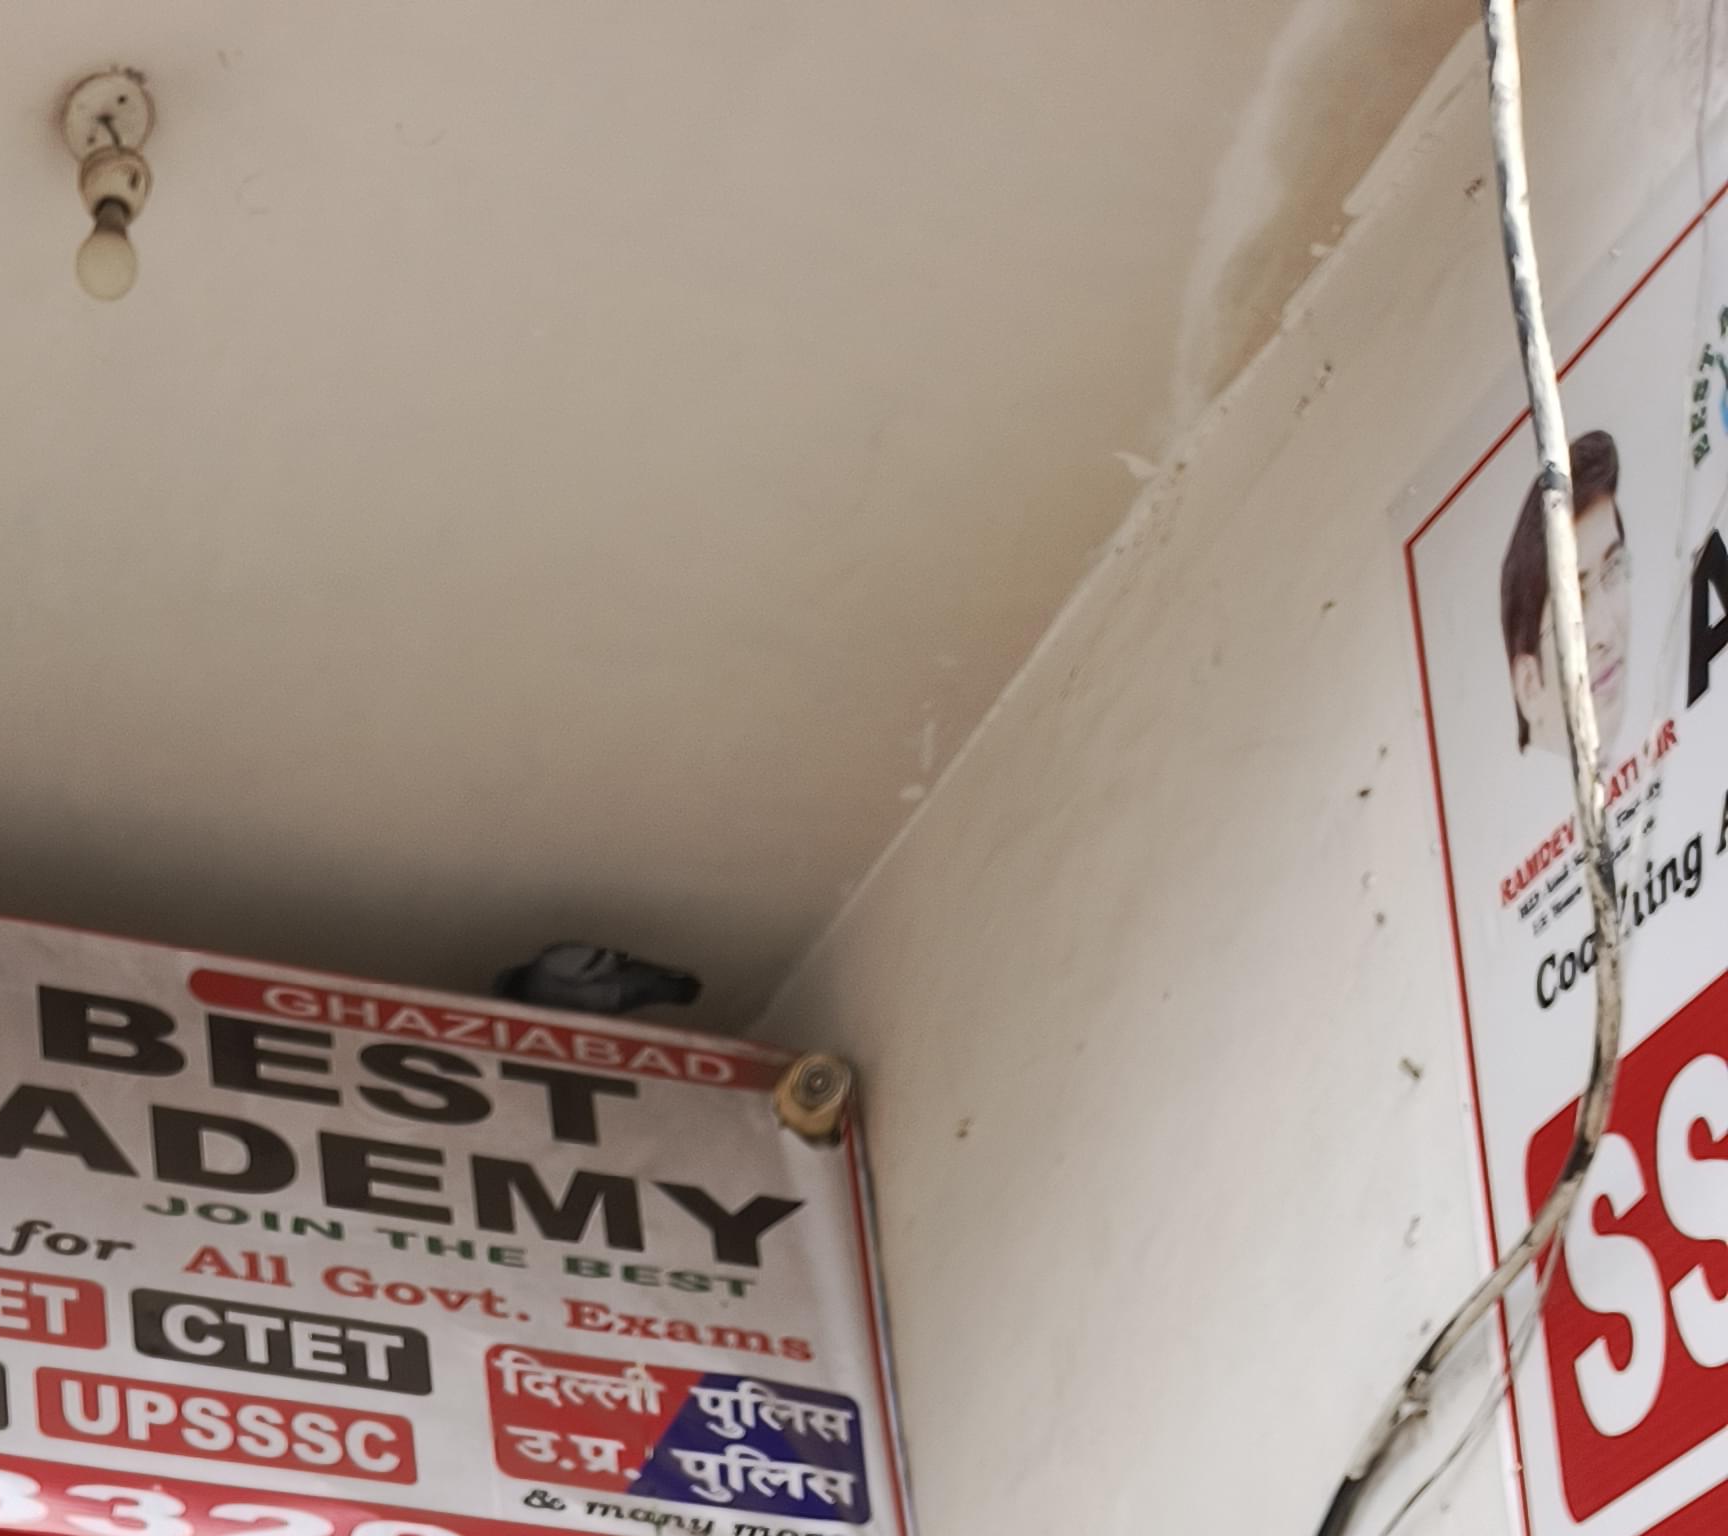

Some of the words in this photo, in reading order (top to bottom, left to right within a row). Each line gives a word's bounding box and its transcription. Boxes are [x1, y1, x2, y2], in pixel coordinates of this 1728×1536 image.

[36, 983, 639, 1145] BEST
[262, 984, 736, 1087] GHAZIABAD
[144, 1197, 347, 1242] JOIN
[377, 1228, 528, 1270] THE
[562, 1255, 758, 1300] BEST
[159, 1303, 405, 1382] CTET
[183, 1246, 293, 1290] All
[322, 1266, 531, 1323] Govt.
[563, 1299, 816, 1362] Exams
[60, 1378, 402, 1474] UPSSSC
[493, 1349, 665, 1417] दिल्ली
[690, 1380, 854, 1444] पुलिस
[521, 1488, 567, 1512] &
[671, 1444, 858, 1507] पुलिस
